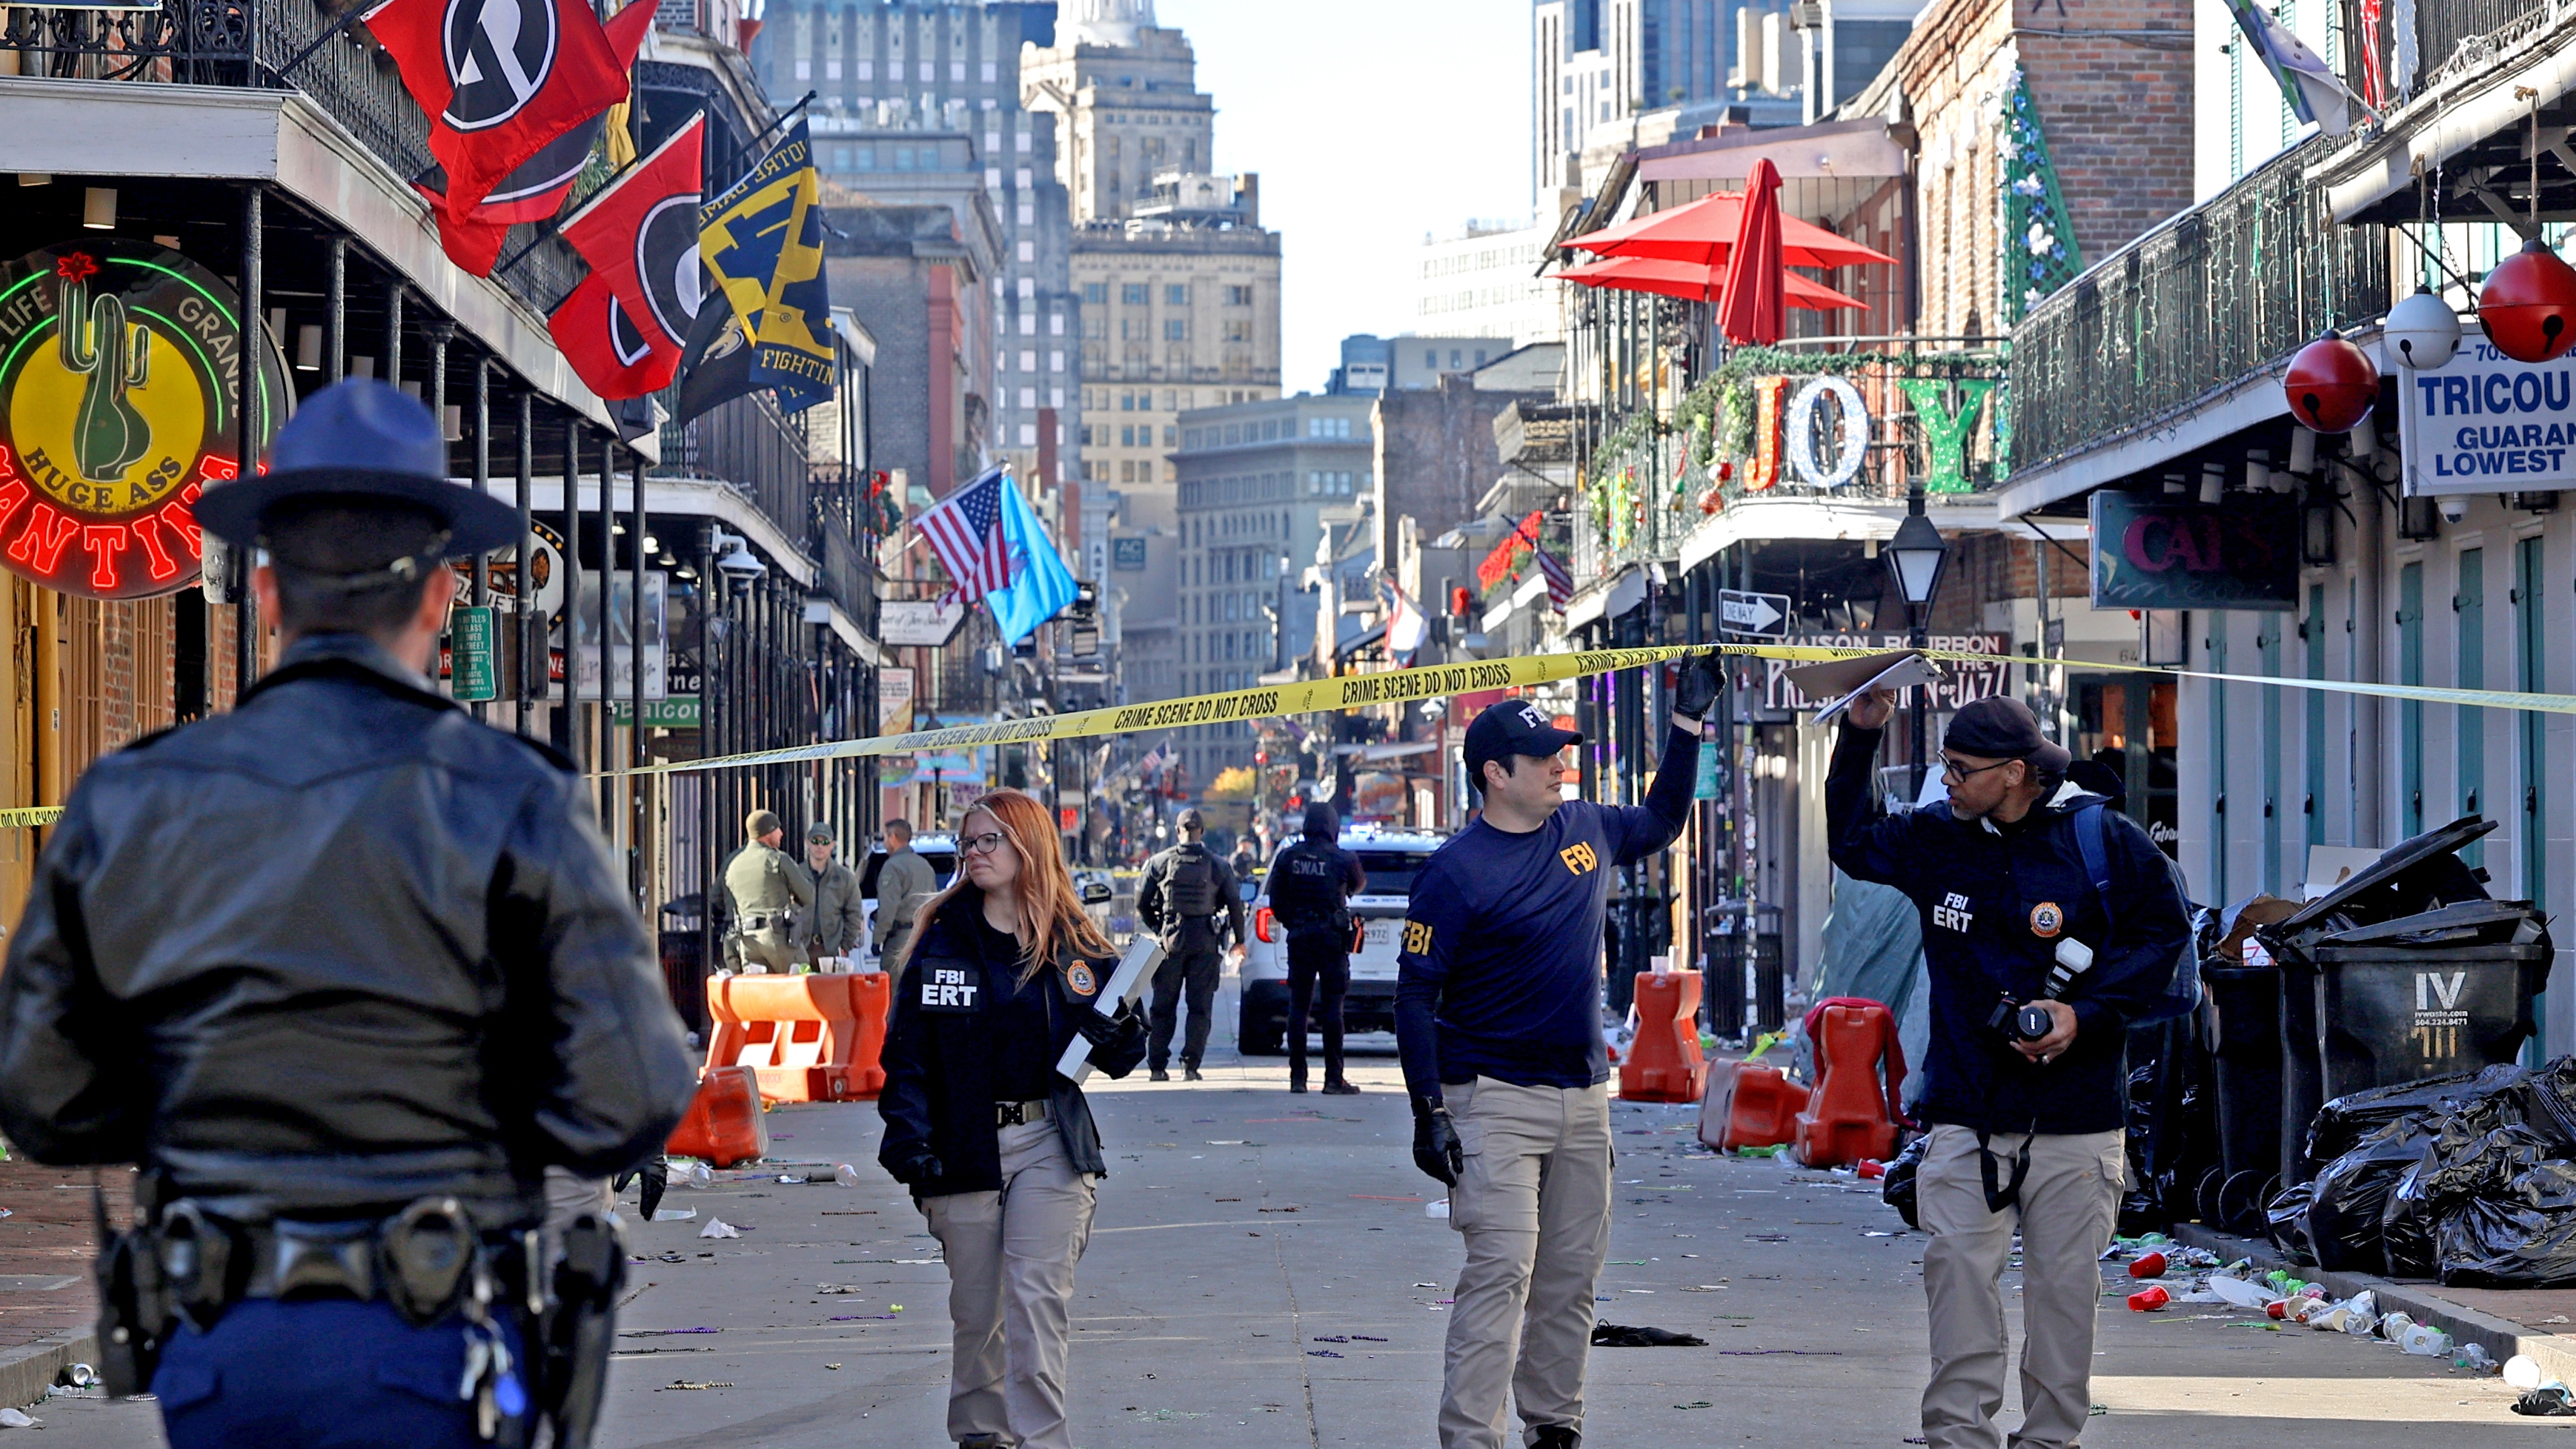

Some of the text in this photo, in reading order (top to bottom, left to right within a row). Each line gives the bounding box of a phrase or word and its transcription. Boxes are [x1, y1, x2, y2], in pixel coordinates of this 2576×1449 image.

[2417, 371, 2571, 416] TRICOU
[1743, 374, 1996, 494] JOY
[2435, 448, 2566, 477] LOWEST
[23, 446, 182, 509] HUGE ASS
[1724, 603, 1755, 621] ONE WAY
[1575, 653, 1618, 673] CRIME
[1342, 678, 1379, 704] CRIME
[1384, 672, 1421, 700] SCENE
[1424, 670, 1441, 694] DO
[1444, 667, 1467, 692] NOT
[1471, 663, 1511, 688] CROSS
[1939, 684, 1957, 695] OF
[1114, 705, 1155, 729] CRIME
[1154, 701, 1194, 726] SCENE
[1194, 699, 1212, 720] DO
[1212, 696, 1238, 720] NOT
[1239, 691, 1278, 716] CROSS
[894, 732, 936, 750] CRIME
[932, 727, 972, 747] SCENE
[972, 724, 990, 743] DO
[989, 722, 1016, 741] NOT
[1015, 718, 1056, 739] CROSS
[1560, 840, 1599, 876] FBI
[1944, 892, 1969, 911] FBI
[1933, 904, 1973, 933] ERT
[935, 969, 965, 985] FBI
[2416, 972, 2466, 1010] IV
[922, 984, 977, 1007] ERT
[2414, 1010, 2469, 1018] ivwaste.com
[2415, 1018, 2468, 1027] 504.224.8471
